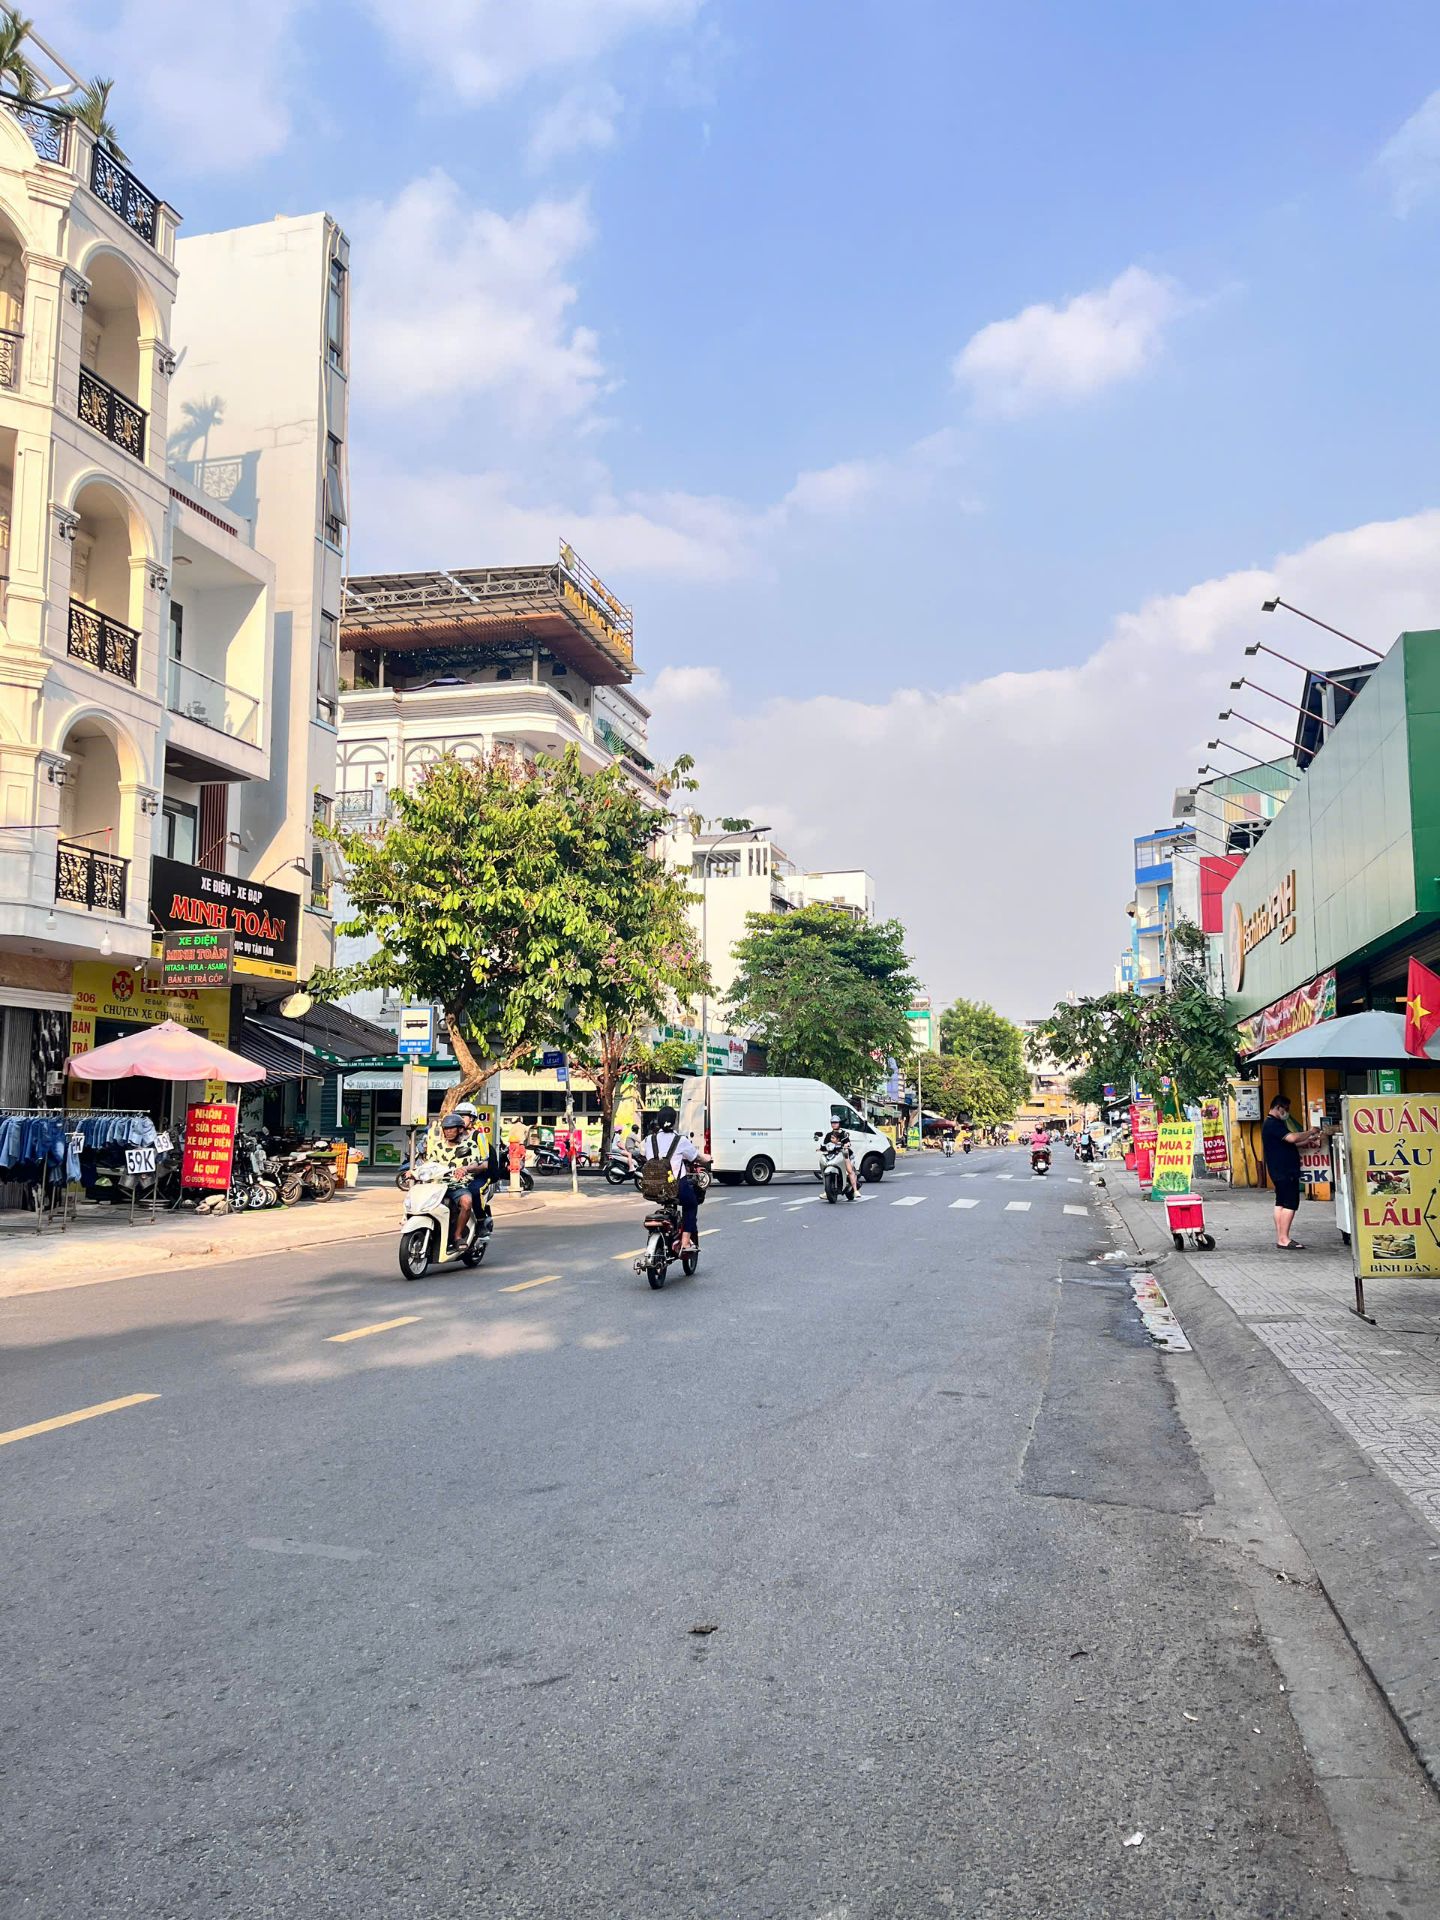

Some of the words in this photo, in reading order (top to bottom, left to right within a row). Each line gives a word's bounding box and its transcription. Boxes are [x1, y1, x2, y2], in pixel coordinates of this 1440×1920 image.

[201, 876, 212, 891] XE
[213, 879, 231, 897] ĐIỆN
[236, 886, 247, 900] XE
[248, 888, 263, 905] ĐẠP
[169, 894, 228, 929] MINH
[231, 907, 286, 941] TOÀN
[178, 937, 192, 946] XE
[194, 936, 217, 946] ĐIỆN
[166, 950, 195, 960] MINH
[198, 946, 228, 960] TOÀN
[165, 964, 184, 972] HITASA
[168, 974, 182, 984] BÁN
[194, 973, 207, 982] TRẢ
[208, 975, 223, 984] GÓP
[77, 992, 96, 1003] 306
[142, 1009, 152, 1019] XE
[72, 1018, 91, 1034] BÁN
[72, 1038, 89, 1055] TRẢ
[195, 1108, 222, 1122] NHẬN
[1353, 1102, 1440, 1135] QUÁN
[195, 1121, 209, 1133] SỬA
[211, 1124, 231, 1134] CHỮA
[187, 1136, 197, 1145] XE
[198, 1137, 212, 1148] ĐẠP
[214, 1137, 231, 1149] ĐIỆN
[1160, 1141, 1183, 1150] MUA
[1185, 1141, 1192, 1150] 2
[1204, 1138, 1225, 1149] 100%
[193, 1150, 210, 1160] THAY
[211, 1150, 229, 1162] BÌNH
[1157, 1152, 1184, 1165] TÍNH
[1186, 1155, 1191, 1165] 1
[1368, 1138, 1433, 1166] LẨU
[127, 1149, 154, 1172] 59K
[205, 1165, 220, 1175] QUY
[1363, 1198, 1422, 1226] LẨU
[1370, 1263, 1400, 1272] BÌNH
[1404, 1263, 1431, 1272] DÂN
